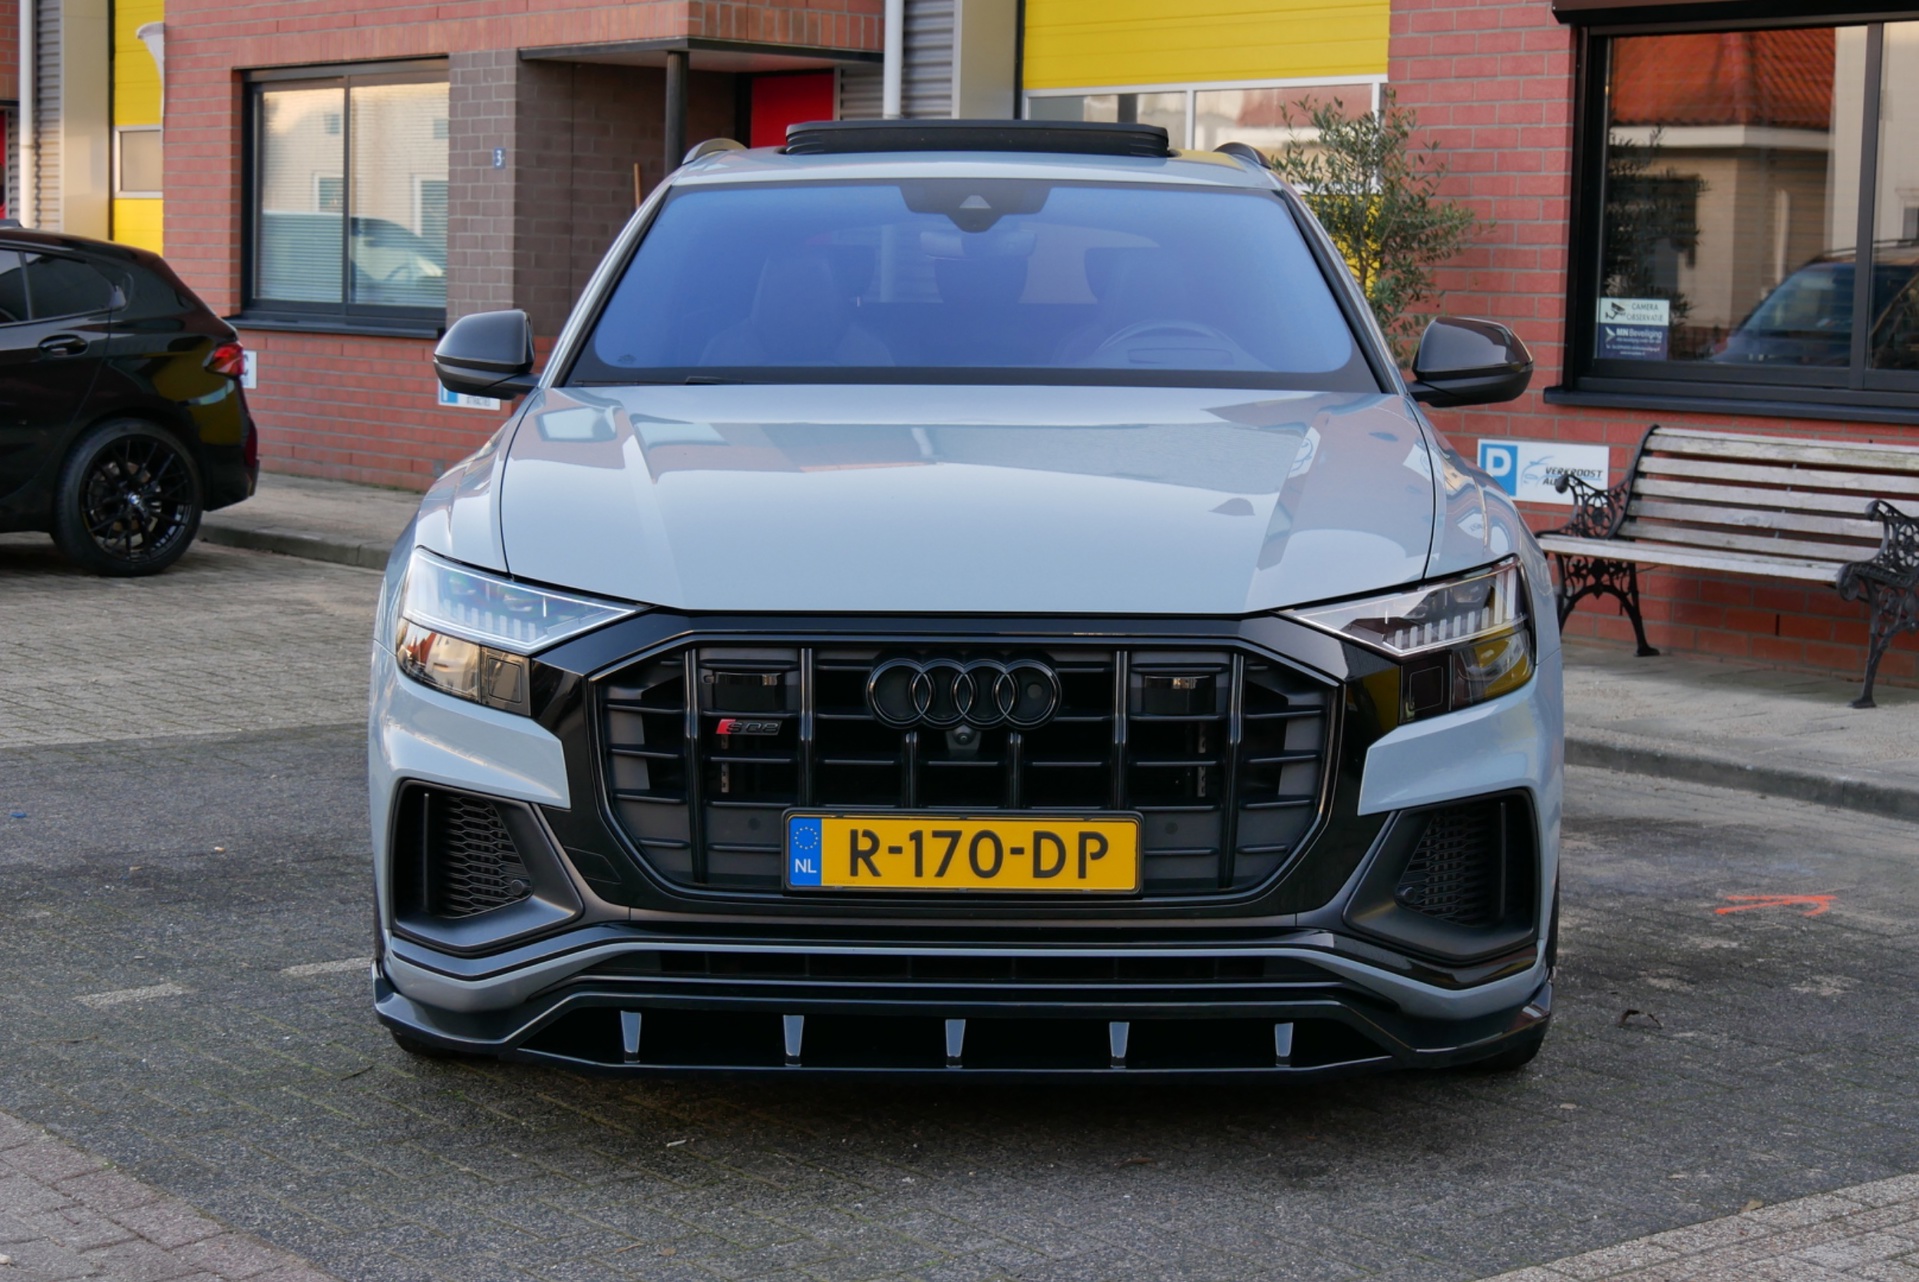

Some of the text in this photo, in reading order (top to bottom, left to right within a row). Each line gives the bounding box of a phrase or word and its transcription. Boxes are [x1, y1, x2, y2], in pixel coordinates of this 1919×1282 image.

[495, 149, 502, 166] 3
[1631, 303, 1659, 311] CAMERA
[1626, 314, 1663, 322] OBSERVATIE
[726, 722, 779, 734] SQ8
[850, 829, 1109, 880] R-170-DP
[795, 859, 817, 873] NL
